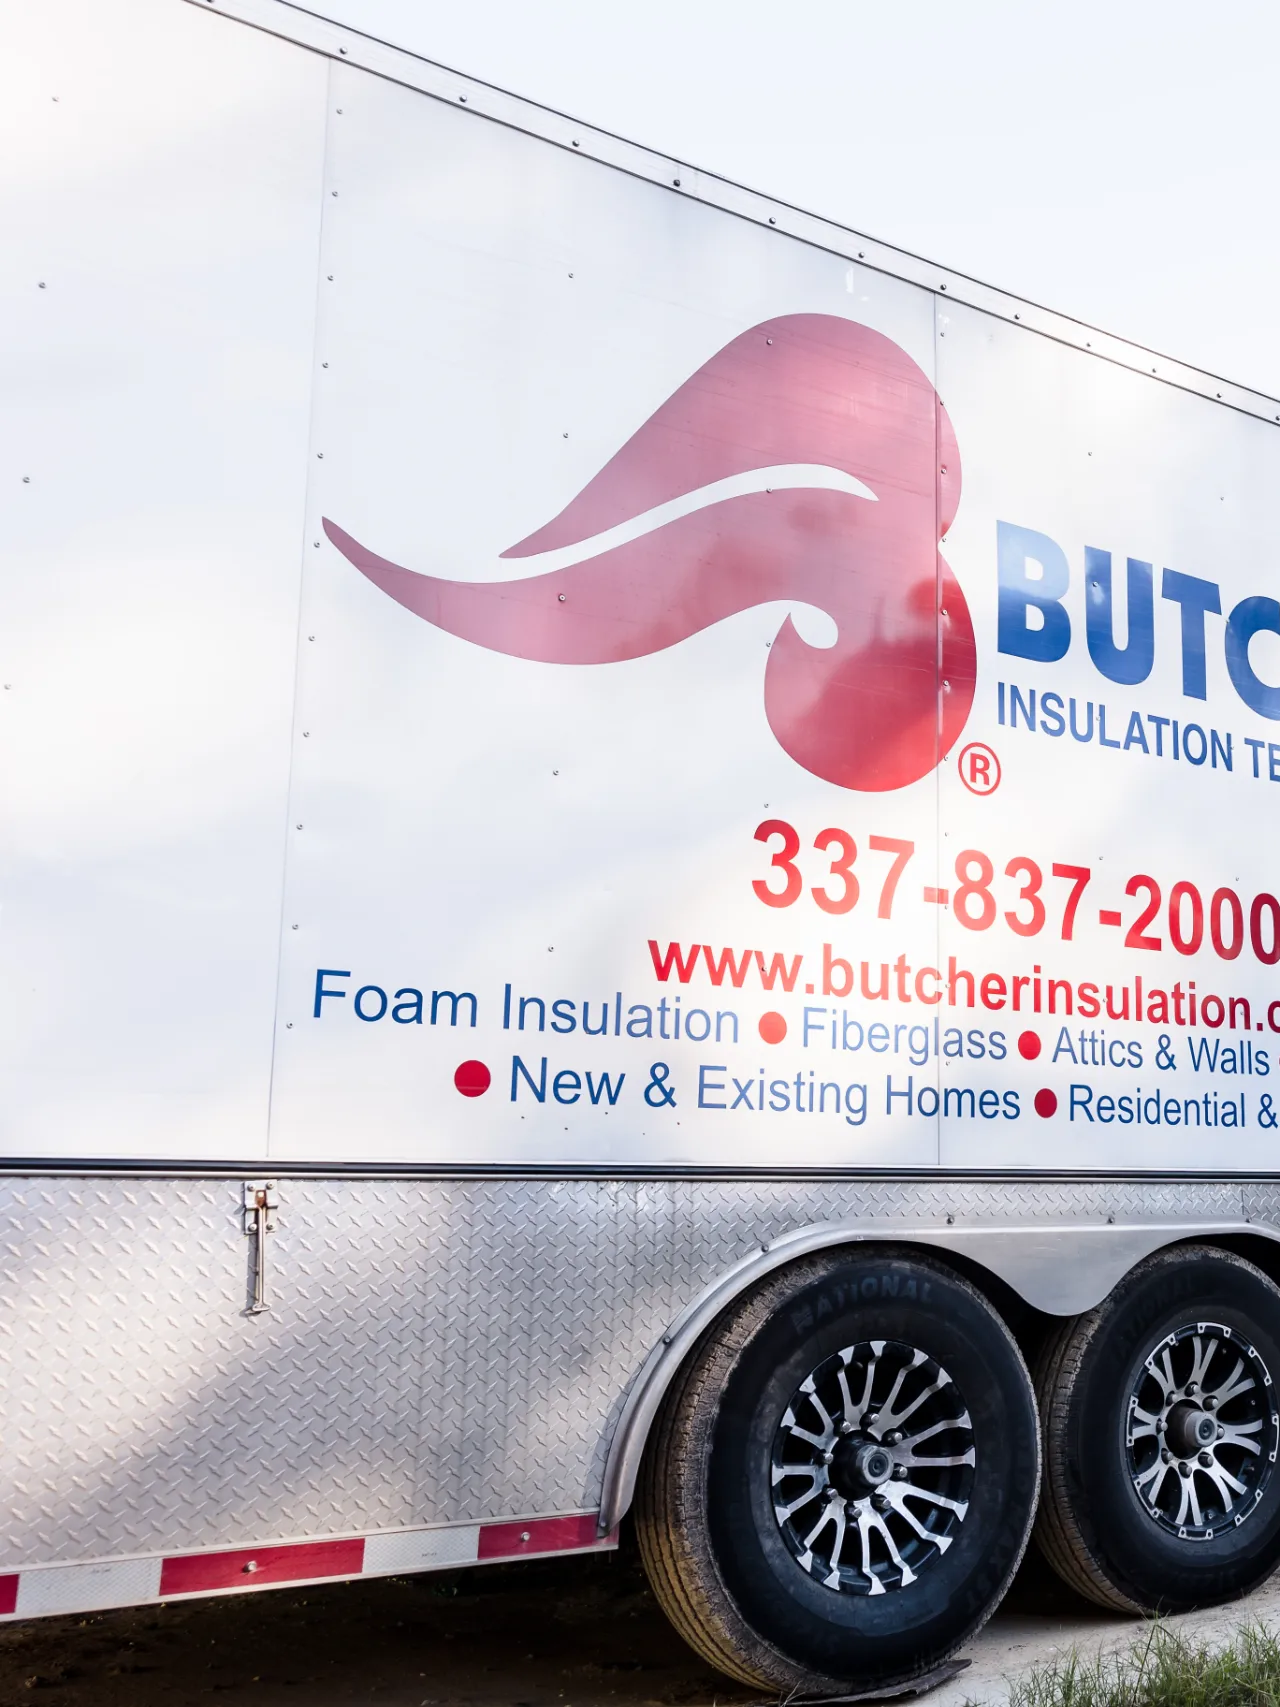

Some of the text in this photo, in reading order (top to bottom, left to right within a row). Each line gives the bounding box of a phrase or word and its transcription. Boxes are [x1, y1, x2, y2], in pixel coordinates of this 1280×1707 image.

[998, 682, 1233, 772] INSULATION
[313, 968, 478, 1027] Foam
[503, 983, 739, 1043] Insulation
[803, 1007, 1008, 1066] Fiberglass
[1053, 1027, 1143, 1069] Attics
[1156, 1034, 1176, 1071] &
[1188, 1036, 1271, 1077] Walls
[511, 1055, 625, 1105] New
[643, 1062, 677, 1108] &
[698, 1065, 866, 1126] Existing
[886, 1076, 1021, 1120] Homes
[1069, 1084, 1247, 1129] Residential
[1256, 1093, 1280, 1129] &
